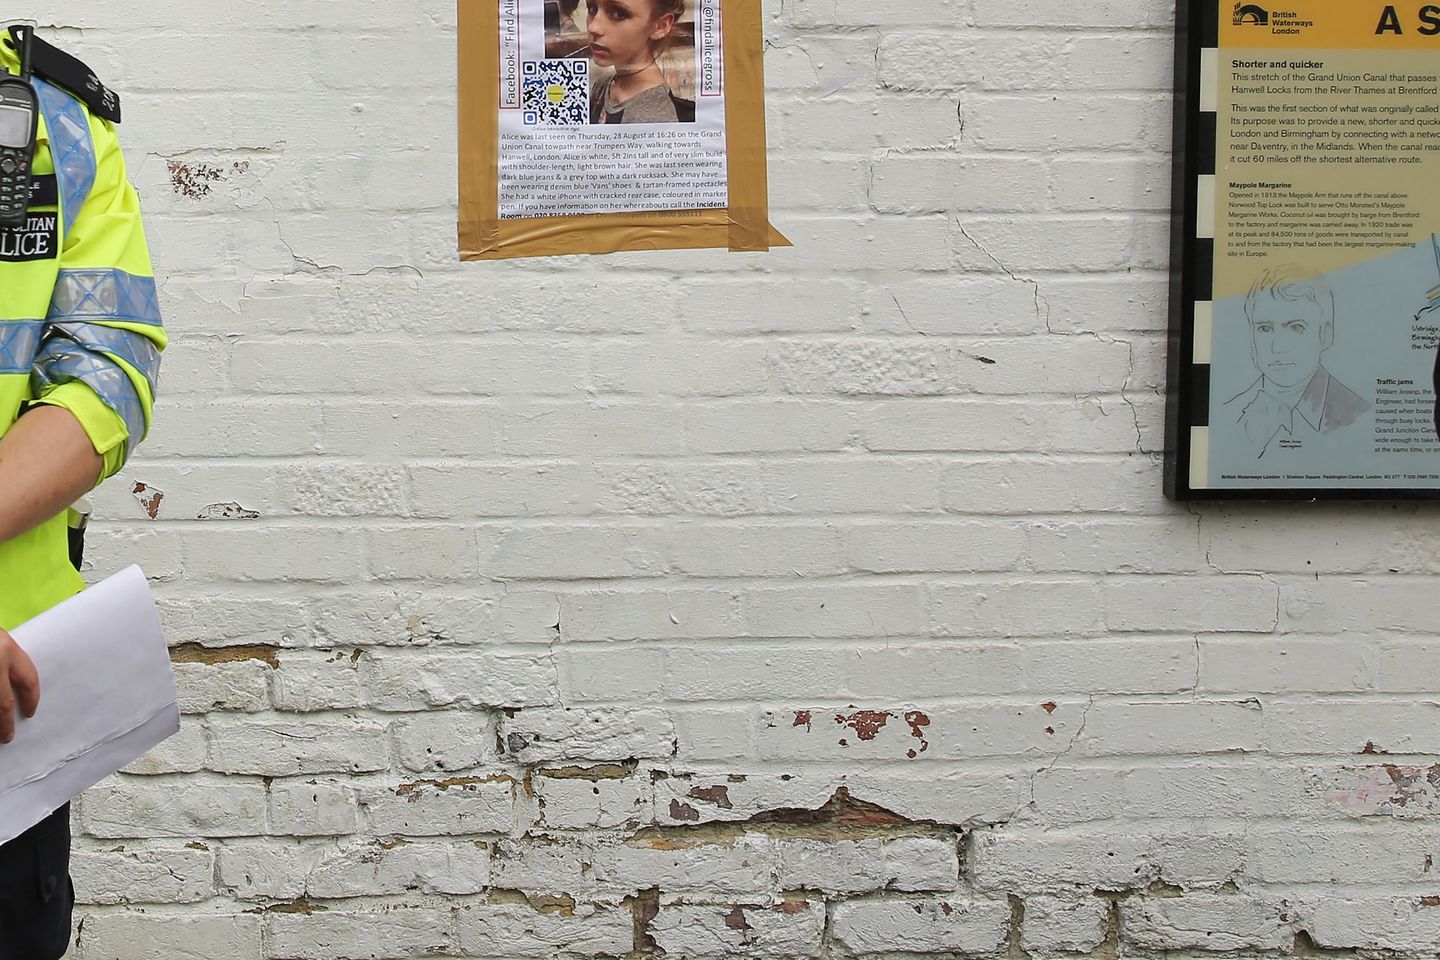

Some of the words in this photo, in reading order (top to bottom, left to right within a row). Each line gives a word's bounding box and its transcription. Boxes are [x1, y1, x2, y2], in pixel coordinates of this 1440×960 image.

[1375, 6, 1402, 35] A
[703, 6, 714, 91] @findalicegross
[1232, 60, 1267, 68] Shorter
[1290, 61, 1324, 70] quicker
[506, 50, 515, 105] Facebook:
[1232, 73, 1248, 81] This
[1251, 73, 1279, 81] stretch
[1282, 73, 1290, 81] of
[1308, 73, 1334, 81] Grand
[1363, 73, 1387, 82] Canal
[1408, 75, 1437, 83] passes
[1232, 86, 1265, 94] Hanwell
[1267, 86, 1291, 94] Locks
[1294, 86, 1312, 94] from
[1330, 86, 1351, 94] River
[1354, 86, 1385, 94] Thames
[1231, 104, 1247, 112] This
[1283, 104, 1297, 112] first
[1380, 105, 1413, 115] originally
[1416, 105, 1439, 113] called
[1253, 155, 1264, 163] 60
[1267, 155, 1289, 163] miles
[1290, 155, 1301, 163] off
[1304, 155, 1317, 163] the
[1319, 155, 1352, 164] shortest
